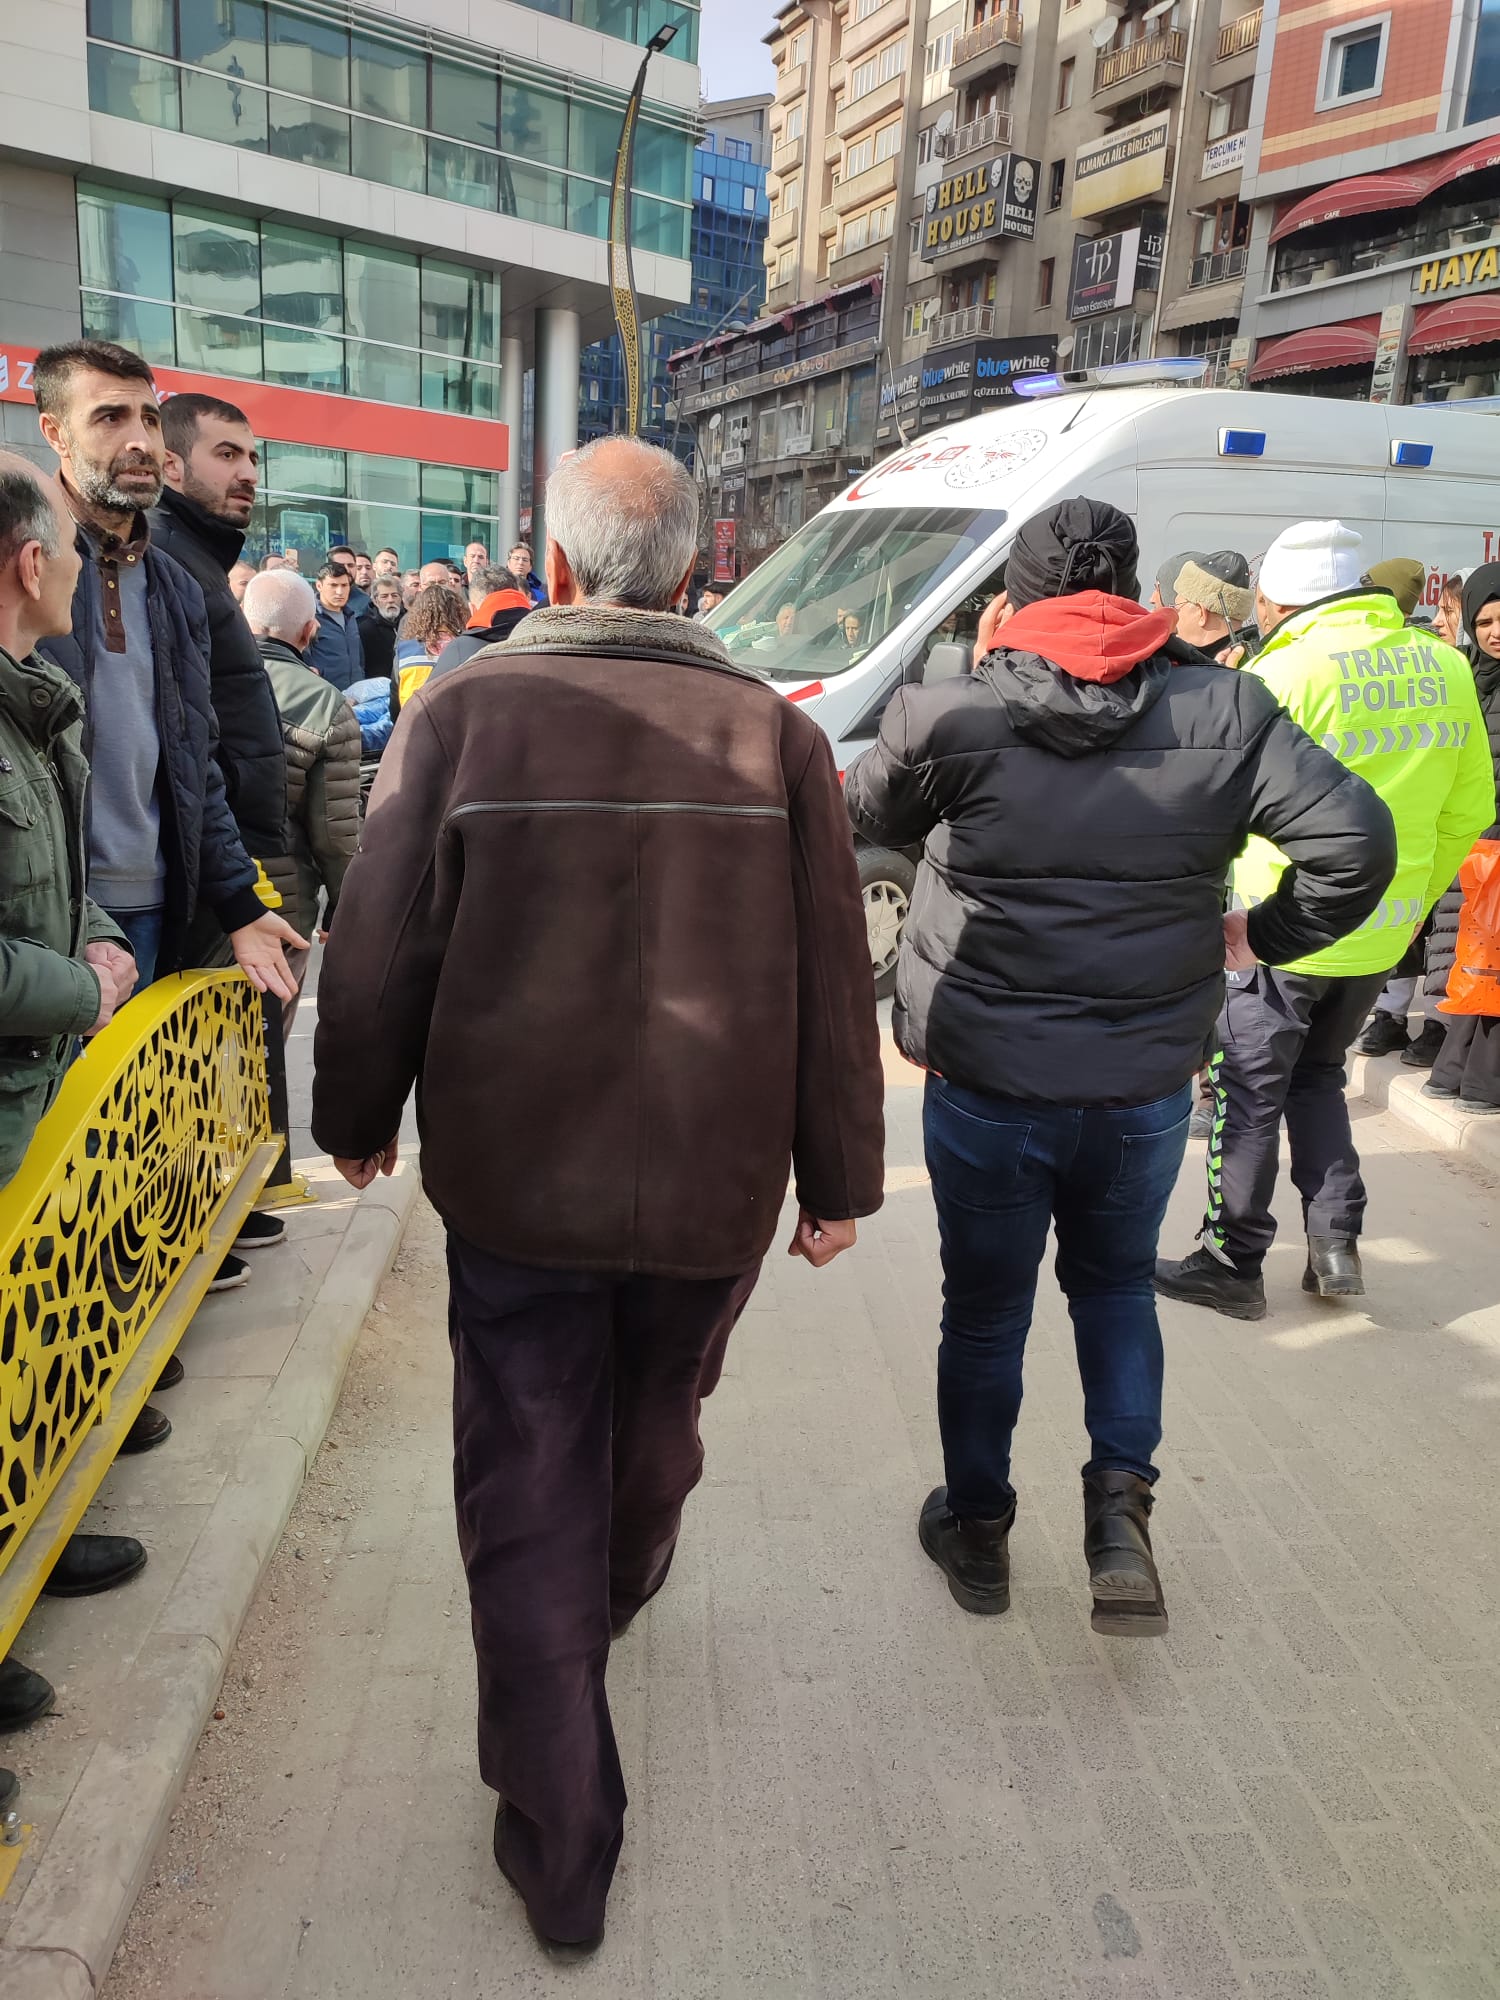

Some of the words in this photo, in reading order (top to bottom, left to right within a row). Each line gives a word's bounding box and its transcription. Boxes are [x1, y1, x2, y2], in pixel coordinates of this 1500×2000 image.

[1078, 153, 1109, 176] ALMANCA
[1110, 143, 1126, 163] AİLE
[1127, 126, 1164, 159] BİRLEŞİMİ
[938, 167, 987, 209] HELL
[926, 198, 997, 248] HOUSE
[1005, 203, 1035, 222] HELL
[1324, 209, 1341, 220] CAFE
[1003, 220, 1034, 236] HOUSE
[976, 355, 1050, 378] bluewhite
